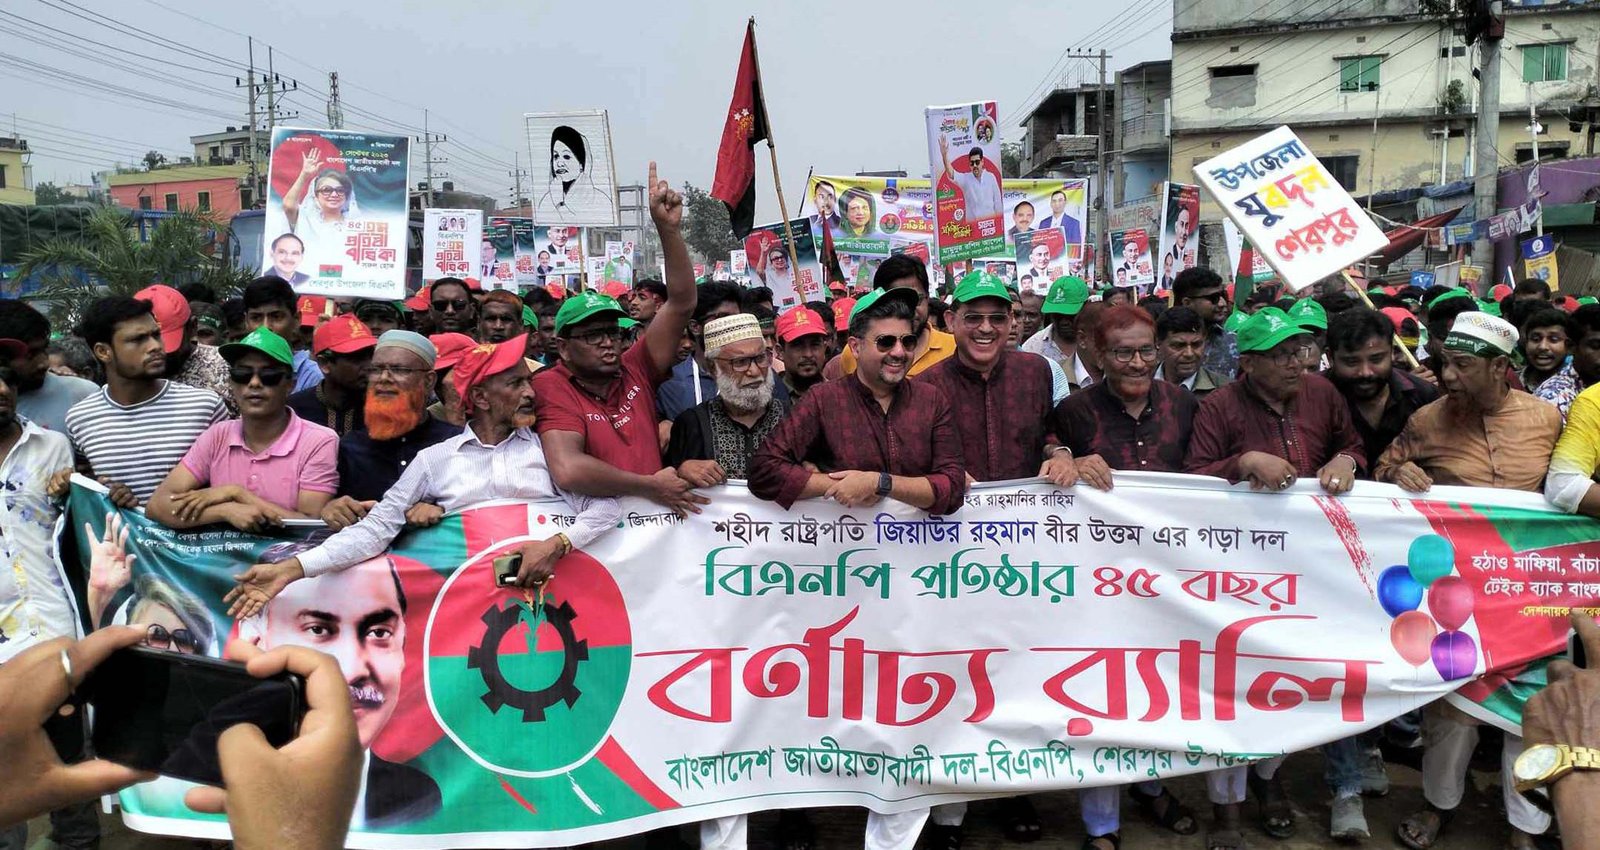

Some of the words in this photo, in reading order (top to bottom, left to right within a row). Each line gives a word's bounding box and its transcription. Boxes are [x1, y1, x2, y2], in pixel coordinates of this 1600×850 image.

[1209, 138, 1307, 190] উপজেলা
[1275, 207, 1359, 262] শেরপুর
[712, 513, 771, 545] শহীদ
[779, 513, 867, 546] রাষ্ট্রপতি
[873, 512, 962, 545] জিয়াউর
[968, 517, 1038, 546] রহমান
[1044, 515, 1081, 546] বীর
[1087, 519, 1144, 546] উত্তম
[1153, 524, 1188, 548] এর
[1198, 525, 1240, 553] গড়া
[1250, 529, 1289, 552] দল
[699, 546, 897, 600] বিএনপি
[910, 547, 1079, 604] প্রতিষ্ঠার
[1092, 566, 1162, 599] ৪৫
[1175, 568, 1304, 612] বছর
[1472, 550, 1509, 572] হঠাও
[1514, 552, 1566, 575] মাফিয়া,
[1484, 575, 1525, 597] টেইক
[1529, 581, 1563, 598] ব্যাক
[634, 604, 1009, 727] বর্ণাঢ্য
[1030, 614, 1384, 736] র‍্যালি
[665, 745, 776, 791] বাংলাদেশ
[782, 735, 934, 788] জাতীয়তাবাদী
[1093, 742, 1172, 778] শেরপুর
